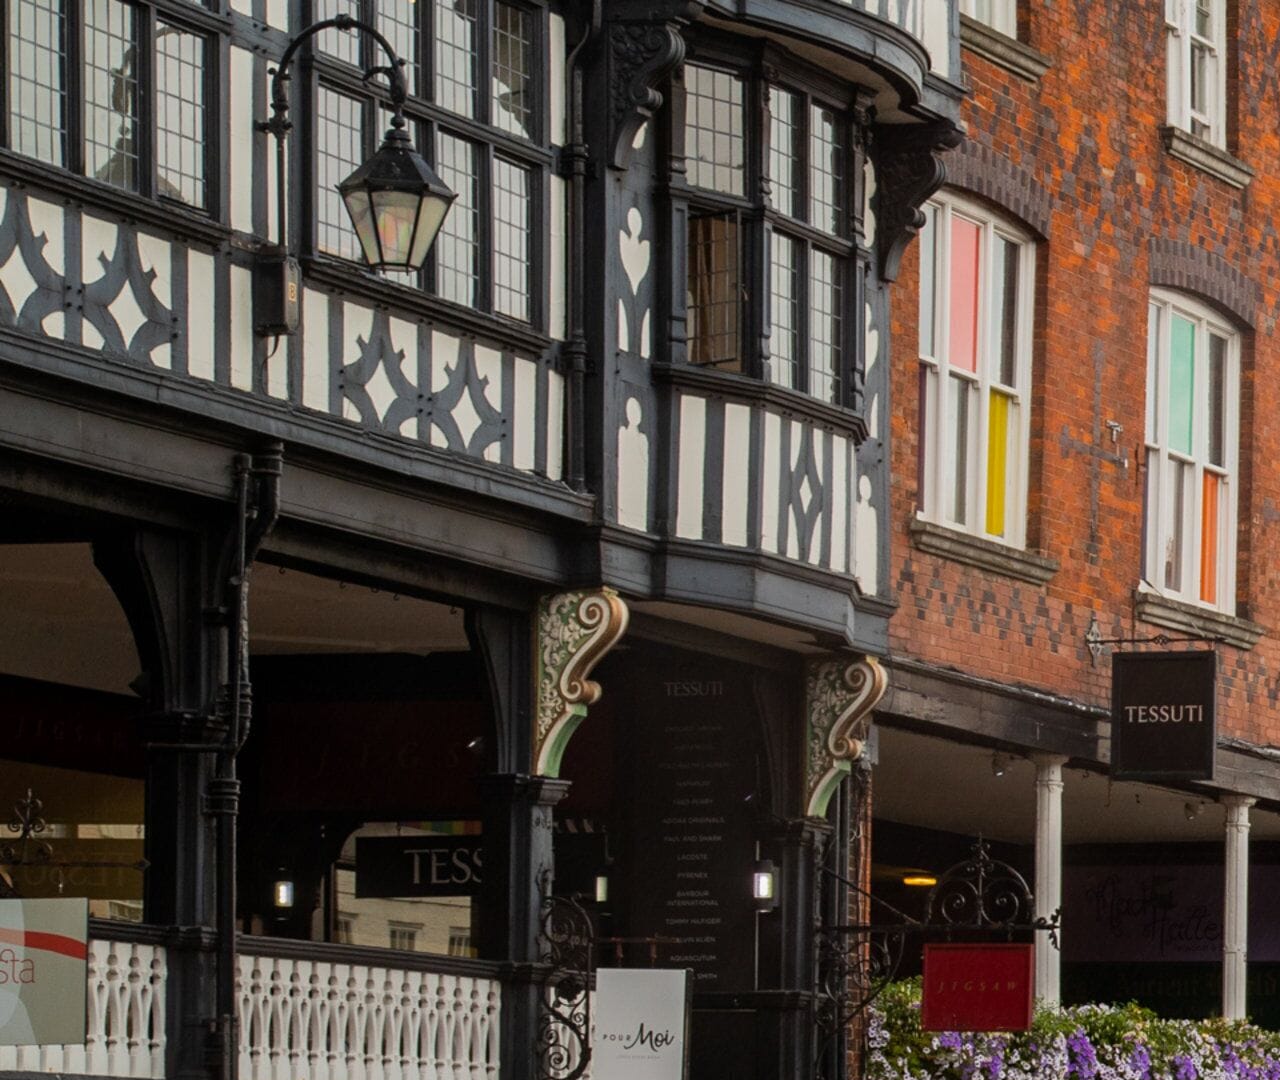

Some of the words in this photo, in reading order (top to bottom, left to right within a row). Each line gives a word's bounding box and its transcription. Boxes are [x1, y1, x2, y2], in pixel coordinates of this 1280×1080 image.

[663, 680, 724, 697] TESSUTI
[1124, 705, 1203, 723] TESSUTI
[938, 980, 1017, 994] JIGSAW
[602, 1033, 631, 1042] POUR
[624, 1022, 675, 1053] Moi
